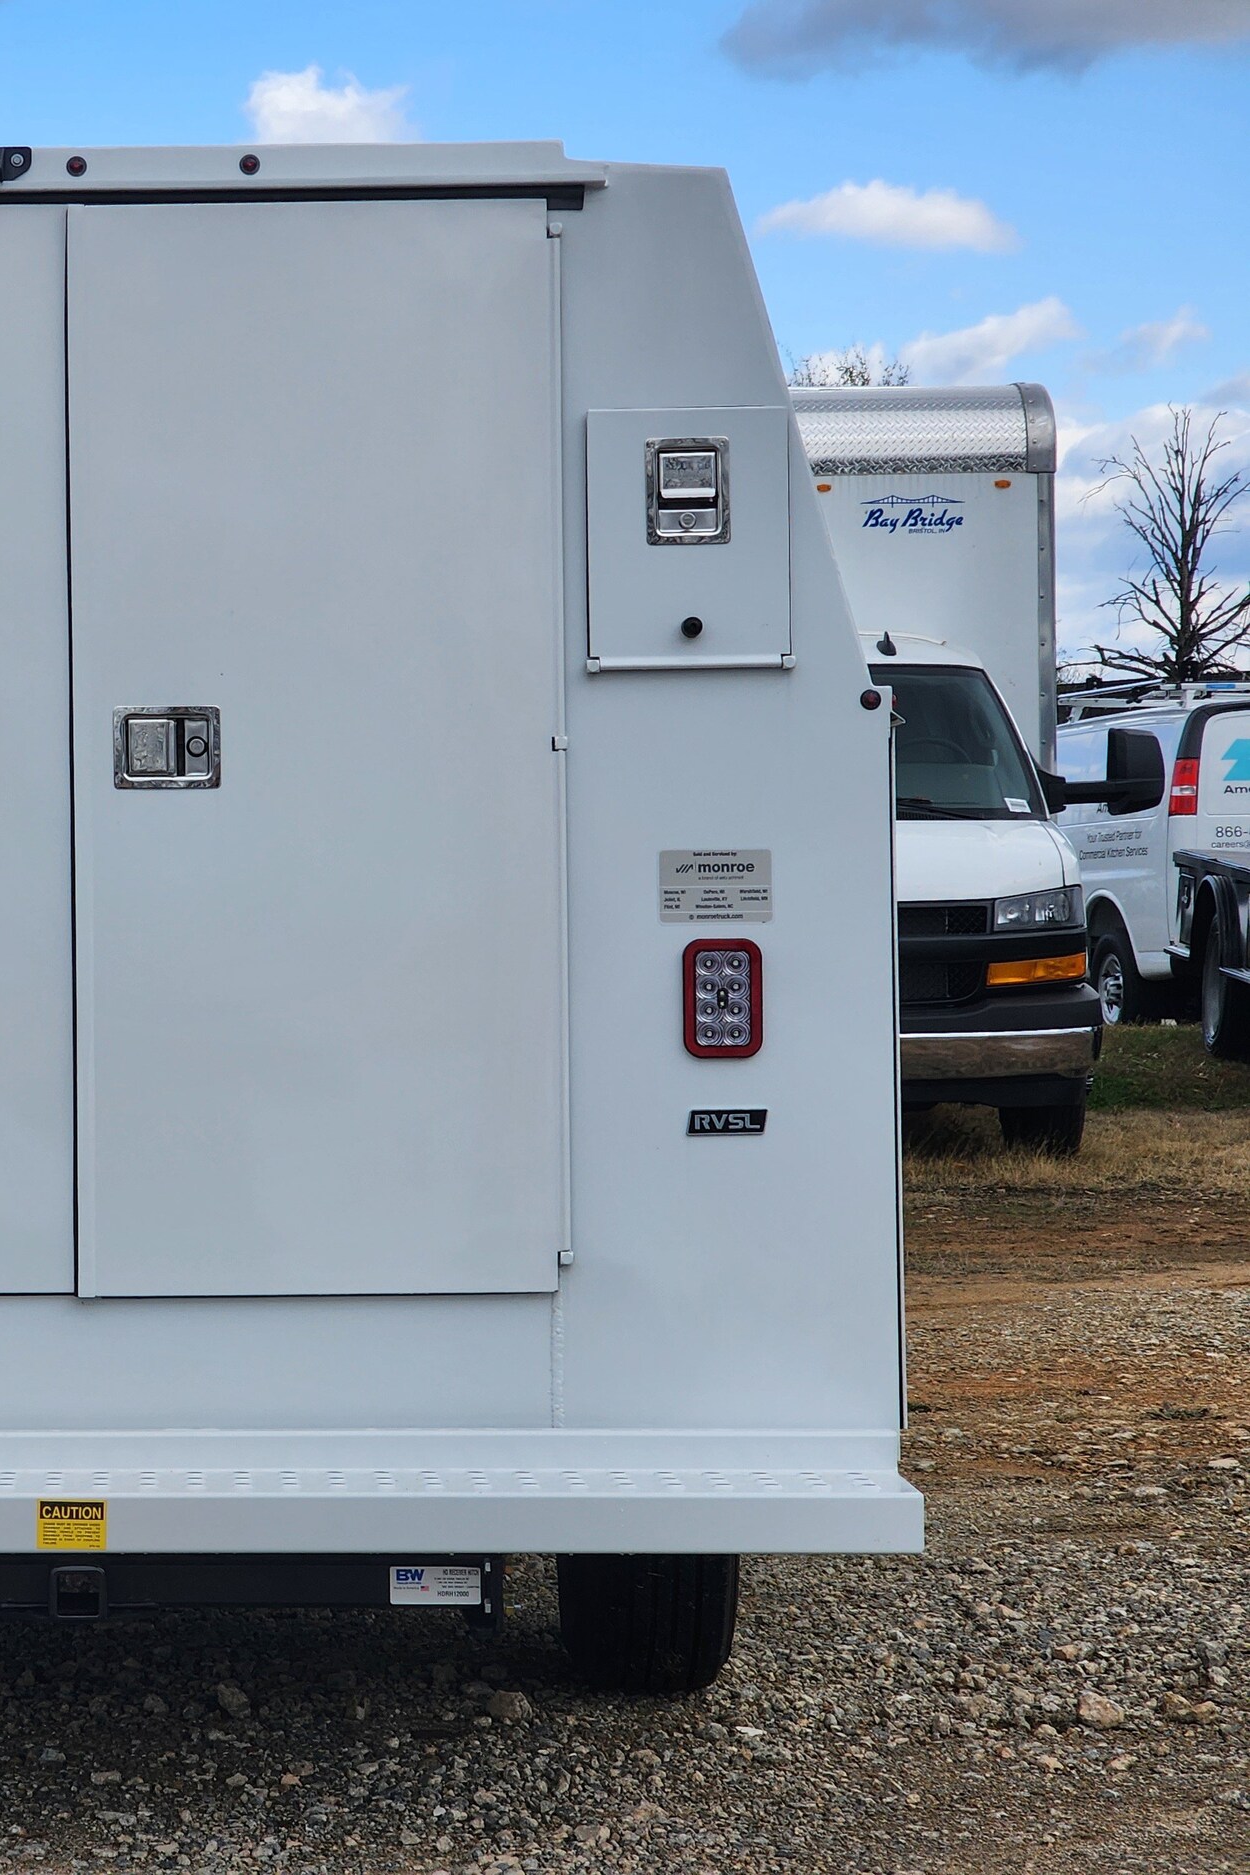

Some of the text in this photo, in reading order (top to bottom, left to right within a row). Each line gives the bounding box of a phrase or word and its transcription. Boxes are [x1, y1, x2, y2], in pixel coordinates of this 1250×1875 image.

[862, 507, 964, 534] Bay Bridge
[1216, 826, 1250, 838] 866-
[698, 863, 755, 873] monroe
[694, 1113, 761, 1130] RVSL
[42, 1506, 102, 1520] CAUTION
